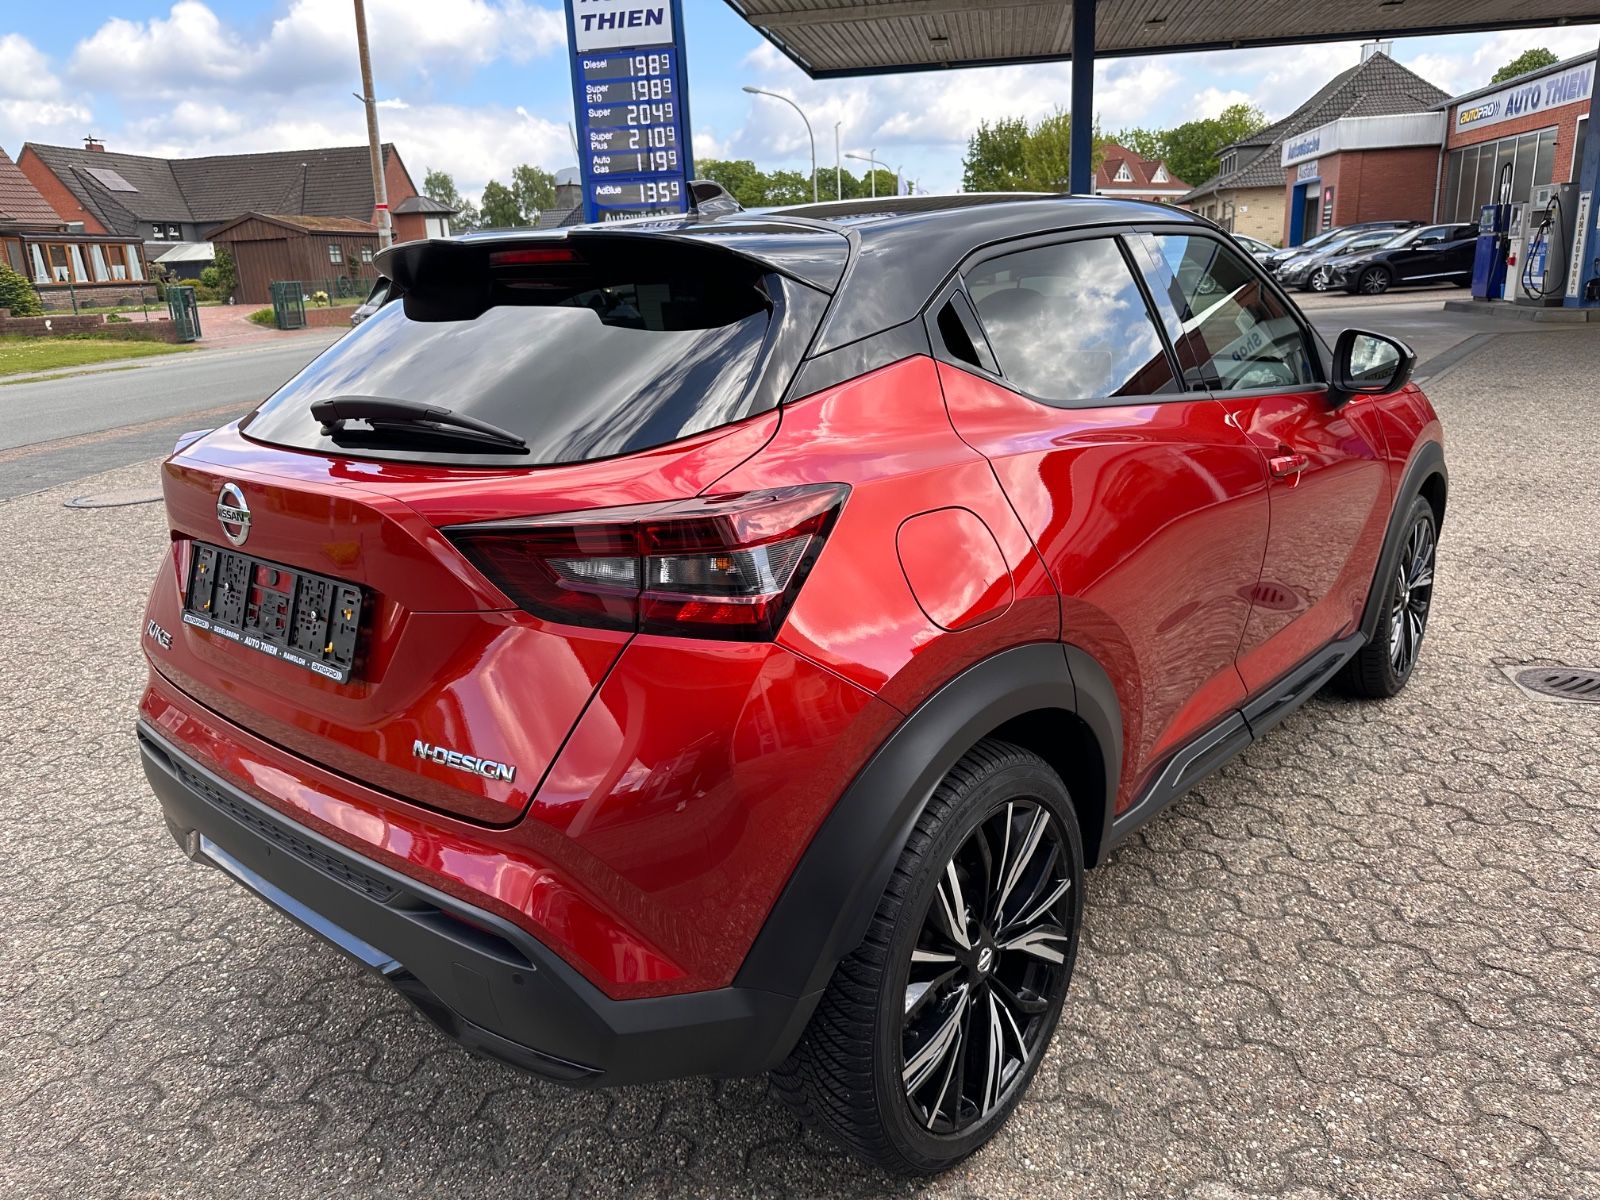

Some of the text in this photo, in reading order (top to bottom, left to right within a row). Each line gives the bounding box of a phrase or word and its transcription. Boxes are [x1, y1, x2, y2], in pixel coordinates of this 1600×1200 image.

[581, 8, 664, 32] THIEN
[583, 54, 670, 77] Diesel 1989
[585, 78, 672, 101] Super 1989
[586, 94, 603, 103] E10
[1505, 84, 1541, 117] AUTO
[1545, 69, 1591, 106] THIEN
[588, 102, 673, 126] Super 2049
[590, 132, 613, 141] Super
[591, 142, 608, 151] Plus
[593, 150, 677, 172] Auto 1199
[593, 166, 610, 174] Gas
[595, 181, 679, 203] AdBlue 1359
[244, 636, 260, 649] AUTO
[260, 641, 278, 656] THIEN
[412, 739, 517, 783] N-DESIGN
